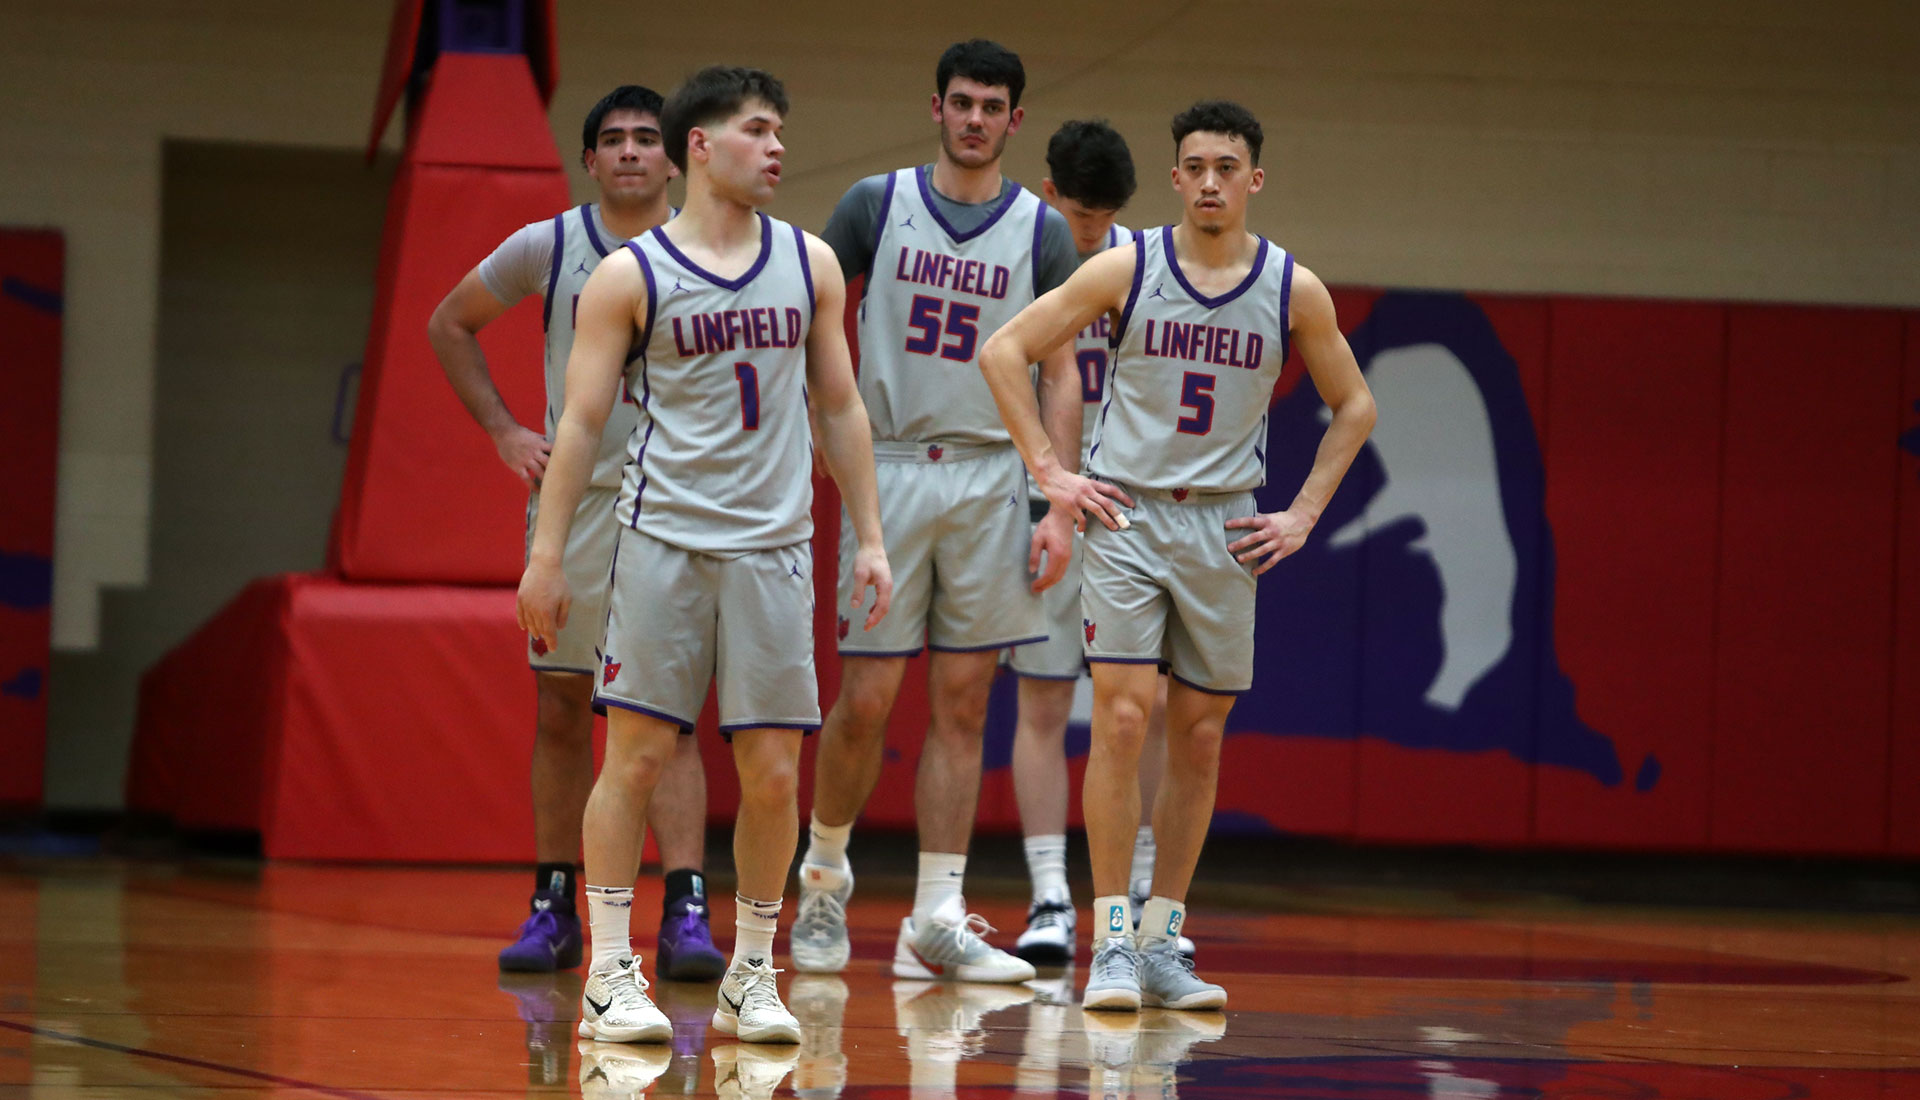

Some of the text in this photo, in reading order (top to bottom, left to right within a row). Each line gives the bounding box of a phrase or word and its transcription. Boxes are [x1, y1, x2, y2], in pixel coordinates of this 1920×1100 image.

[897, 246, 1010, 300] LINFIELD
[672, 307, 803, 358] LINFIELD
[905, 294, 981, 363] 55
[1144, 318, 1264, 370] LINFIELD
[734, 362, 760, 431] 1
[1176, 371, 1217, 436] 5
